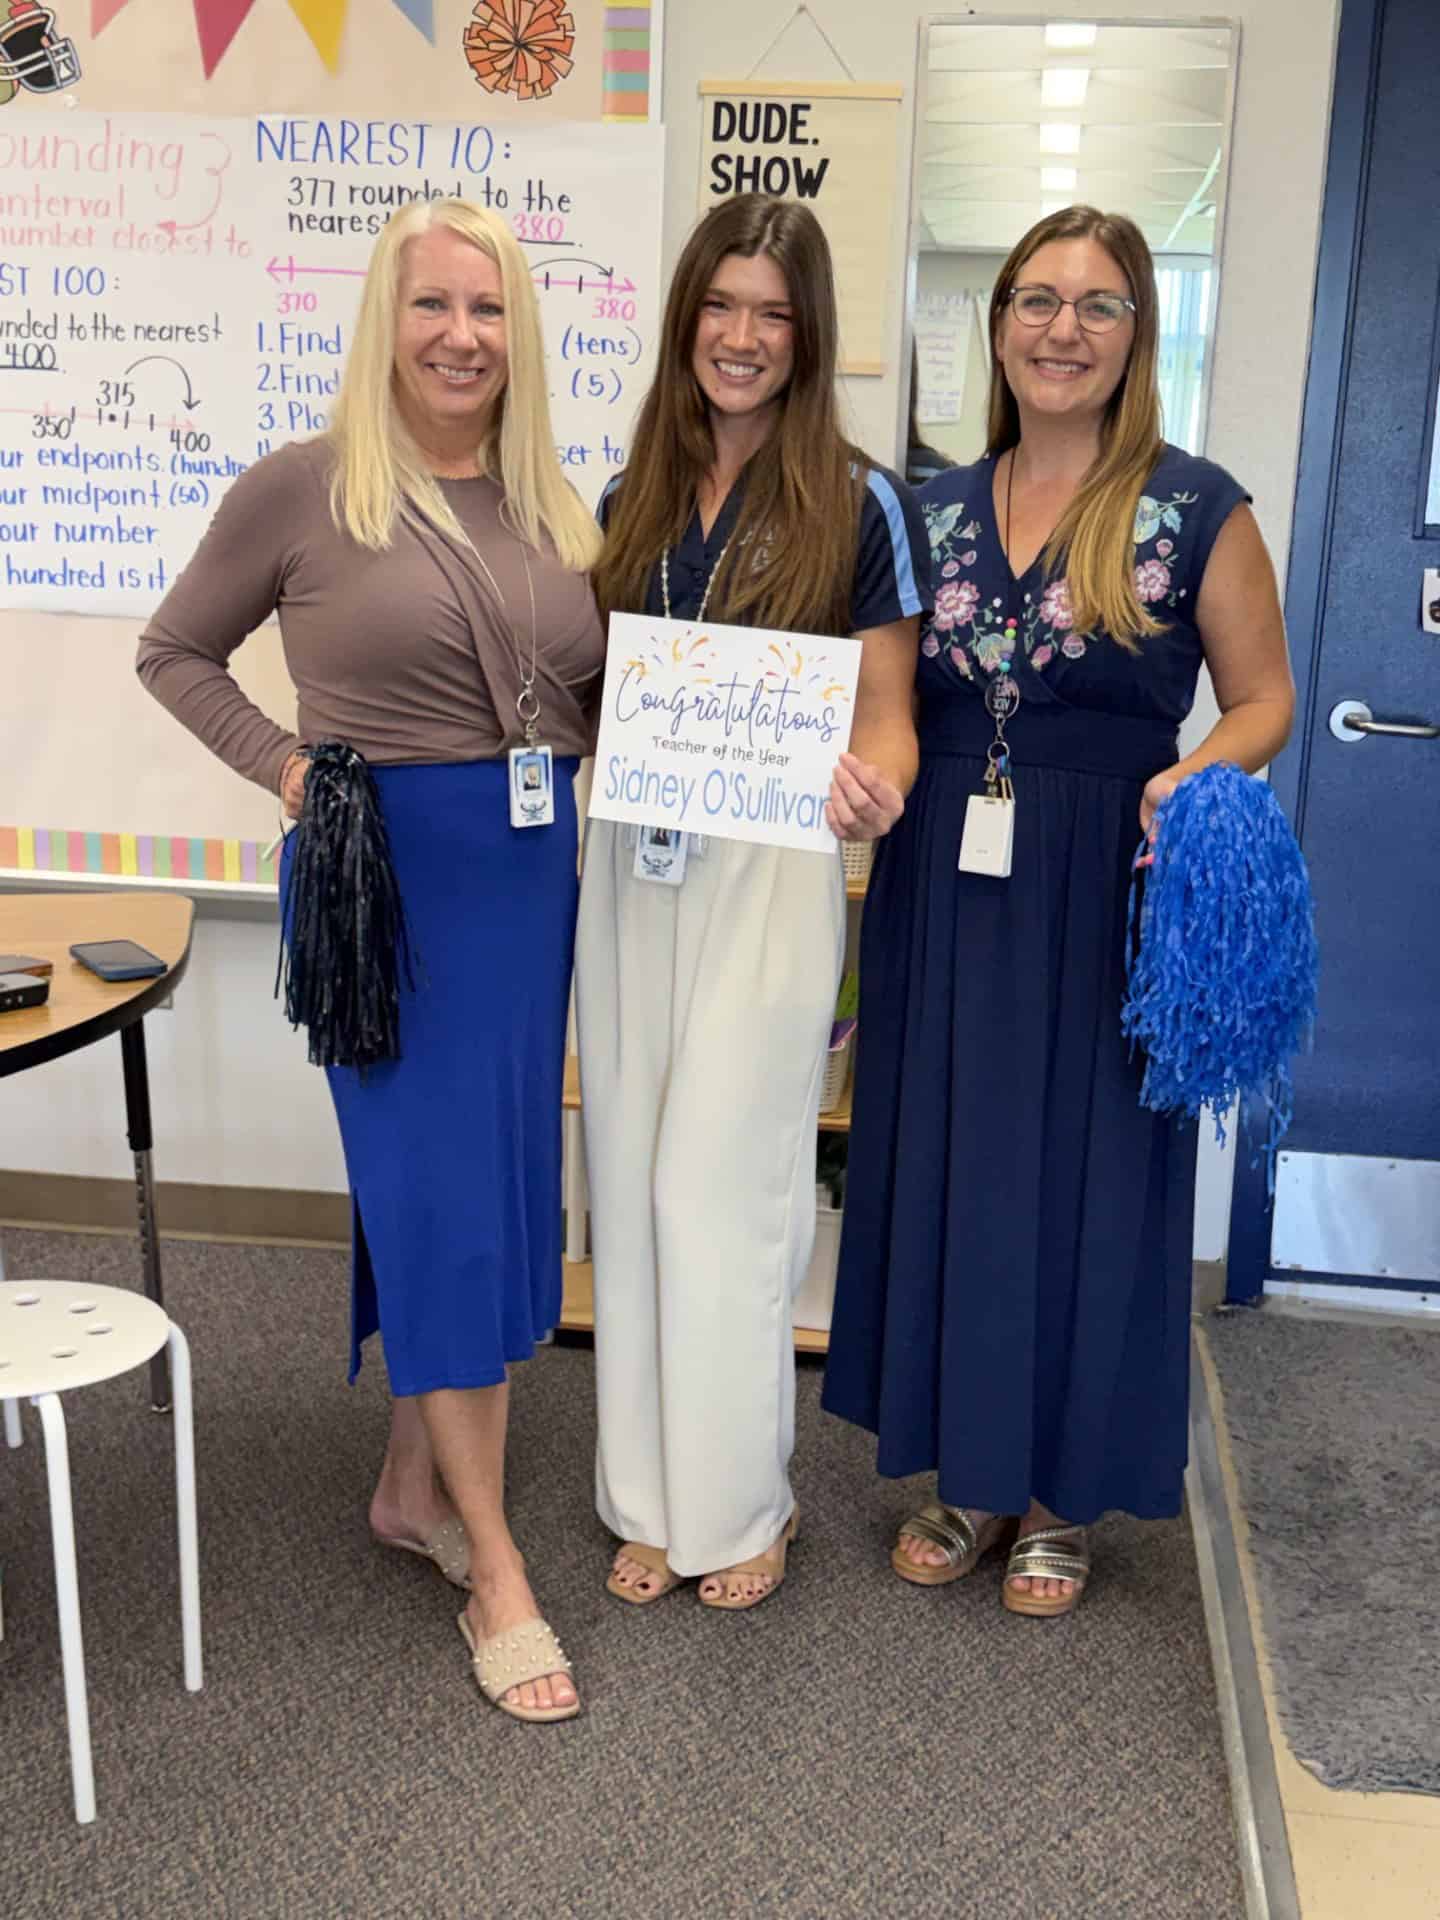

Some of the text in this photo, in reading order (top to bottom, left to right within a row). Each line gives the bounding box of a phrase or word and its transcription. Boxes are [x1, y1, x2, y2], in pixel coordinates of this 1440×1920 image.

[711, 101, 820, 146] DUDE.
[256, 119, 432, 169] NEAREST
[287, 176, 336, 208] 377
[481, 175, 509, 209] to
[521, 178, 572, 213] the
[710, 153, 831, 198] SHOW
[0, 307, 58, 340] nded
[91, 311, 126, 341] the
[134, 312, 223, 342] nearest
[592, 297, 637, 321] 380
[561, 323, 643, 366] (tens)
[169, 428, 211, 452] 400
[601, 435, 625, 465] to
[0, 486, 28, 505] ur
[42, 480, 160, 513] midpoint
[6, 553, 169, 591] hundred is it
[615, 661, 841, 747] Congratulations
[652, 735, 792, 767] Teacher of the Year
[605, 755, 697, 821] Sidney
